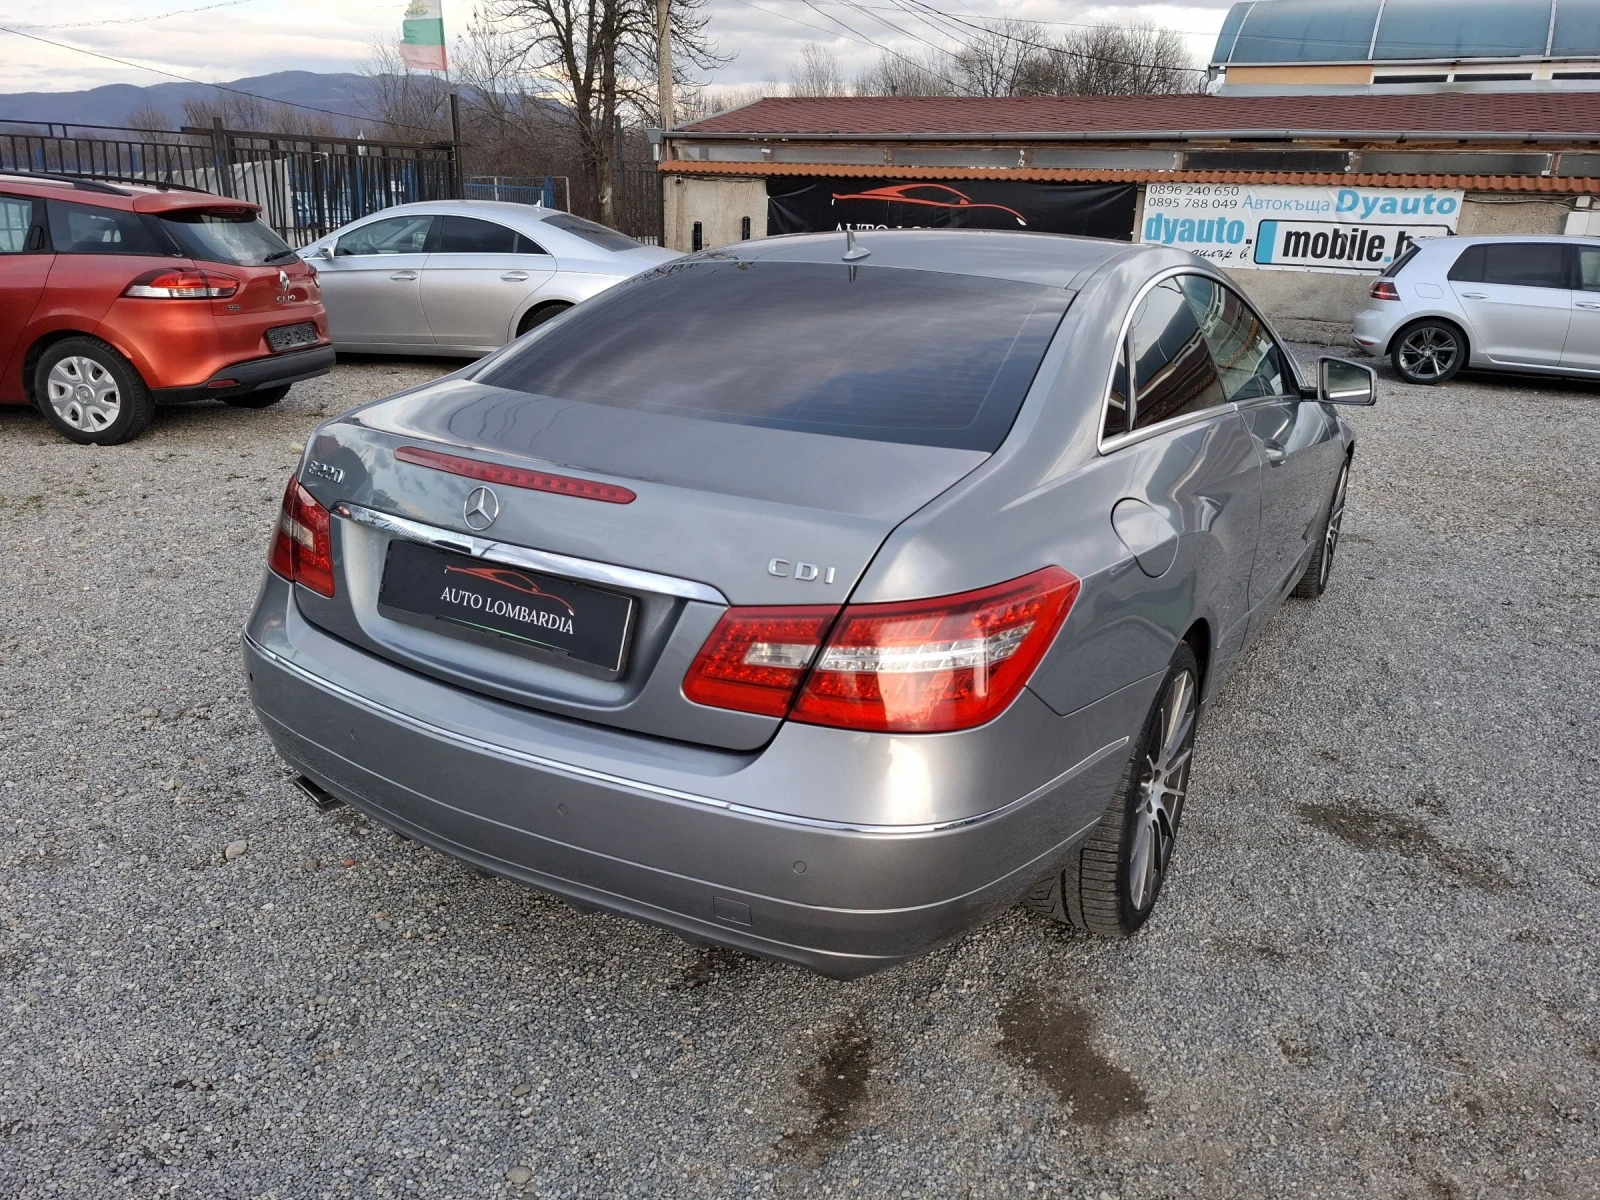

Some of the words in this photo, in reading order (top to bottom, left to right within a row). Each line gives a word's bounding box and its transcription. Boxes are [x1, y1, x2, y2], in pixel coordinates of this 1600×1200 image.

[1148, 197, 1180, 208] 0895
[1185, 198, 1209, 209] 788
[1212, 199, 1238, 210] 049
[1150, 184, 1182, 196] 0896
[1186, 185, 1211, 196] 240
[1214, 186, 1240, 197] 650
[1241, 194, 1330, 214] Автокъща
[1335, 189, 1457, 220] Dyauto
[768, 557, 836, 585] CDI
[440, 586, 483, 609] AUTO
[485, 597, 574, 635] LOMBARDIA
